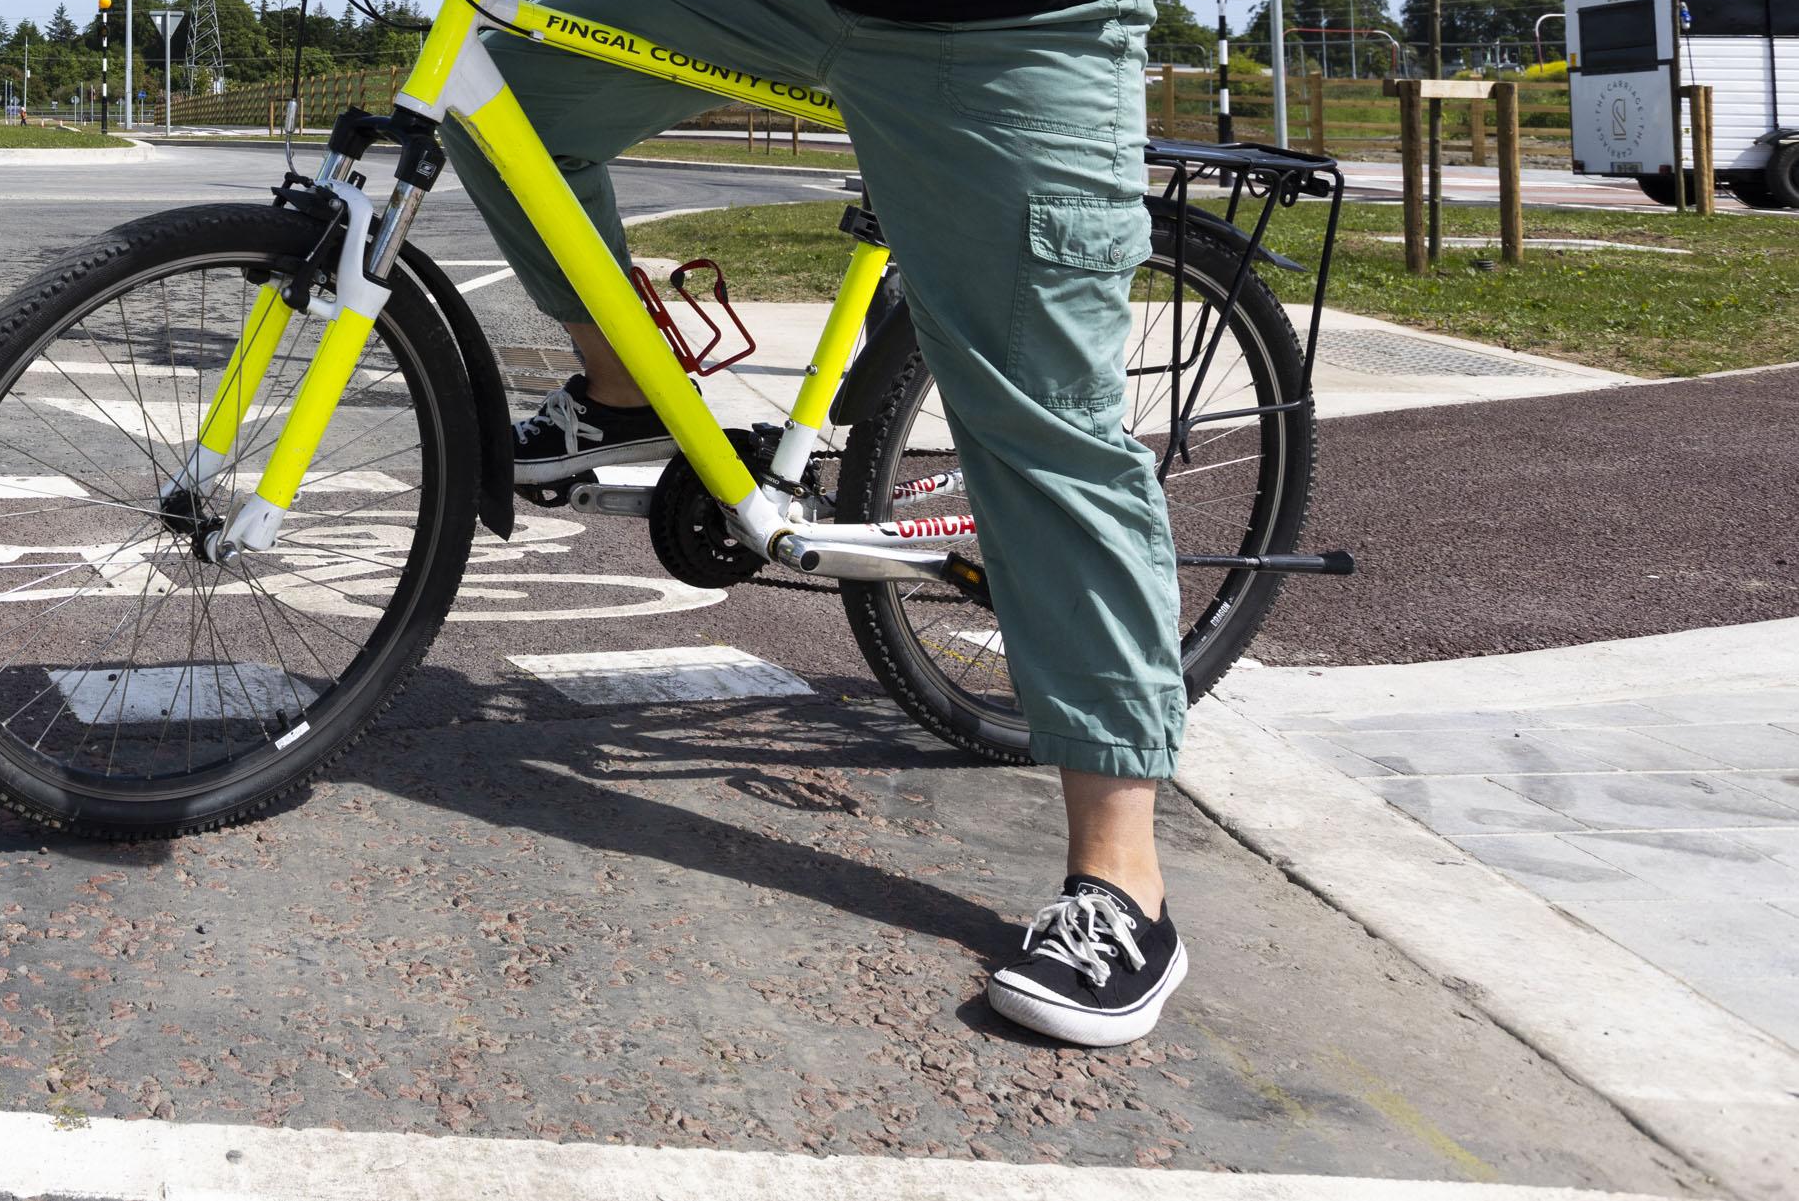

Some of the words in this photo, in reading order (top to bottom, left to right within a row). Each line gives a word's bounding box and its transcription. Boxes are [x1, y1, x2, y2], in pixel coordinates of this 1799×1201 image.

[546, 15, 641, 55] FINGAL
[650, 46, 762, 88] COUNTY
[1606, 80, 1644, 112] CARRIAGE
[1209, 601, 1231, 628] DRAGON
